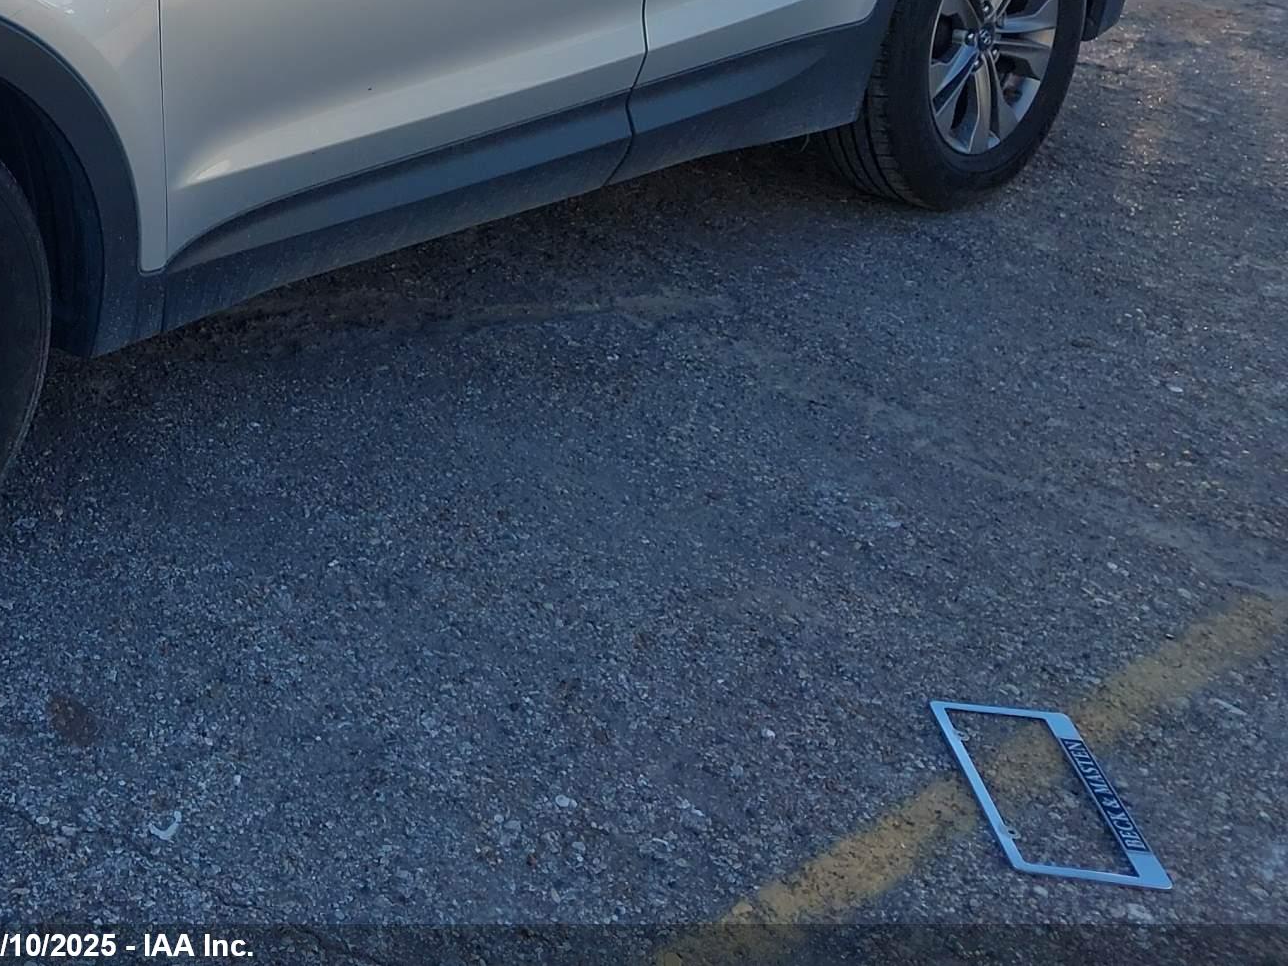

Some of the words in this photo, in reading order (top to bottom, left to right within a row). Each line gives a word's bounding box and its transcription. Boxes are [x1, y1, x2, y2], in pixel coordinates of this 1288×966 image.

[1065, 740, 1113, 794] MASTEN
[1102, 796, 1121, 809] &
[1106, 810, 1147, 850] BECK
